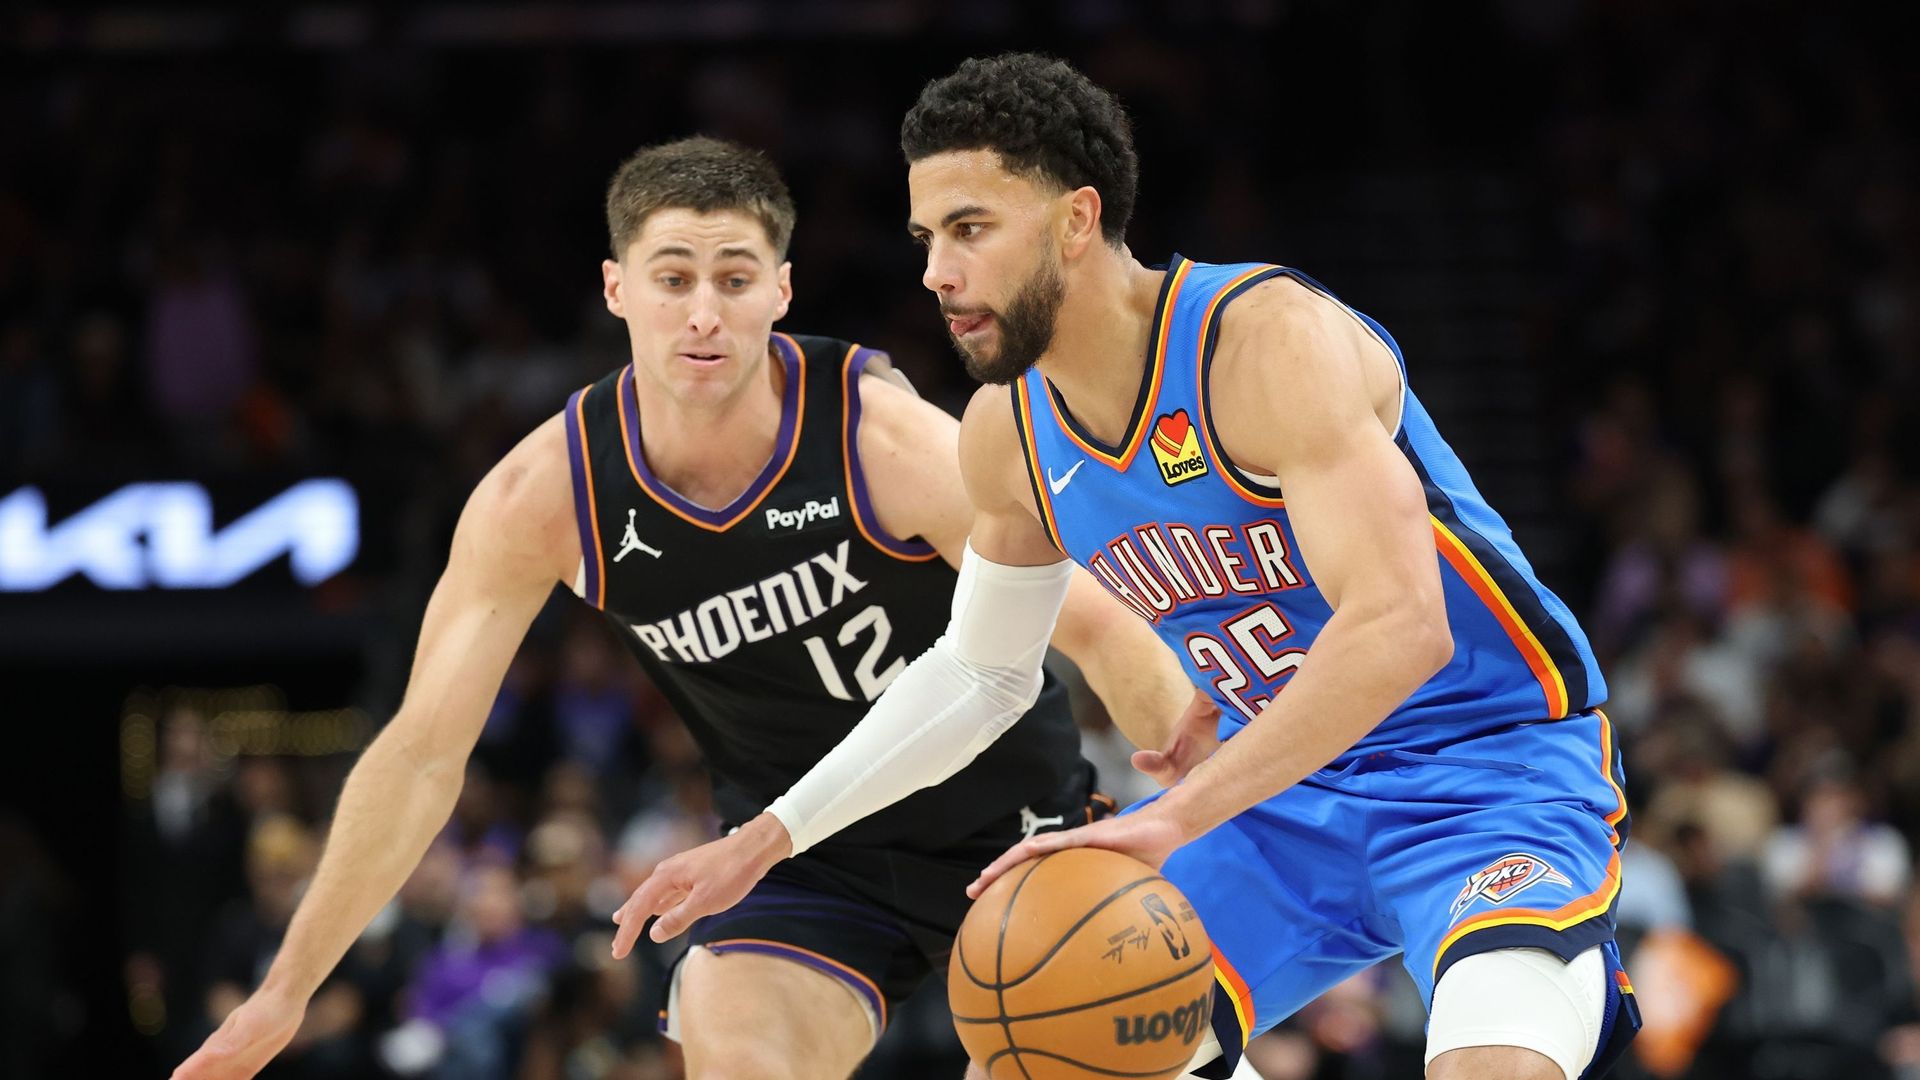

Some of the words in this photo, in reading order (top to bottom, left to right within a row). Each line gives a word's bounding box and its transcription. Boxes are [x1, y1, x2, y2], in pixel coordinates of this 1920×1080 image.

[766, 497, 839, 531] PayPal
[631, 540, 868, 663] PHOENIX
[1088, 518, 1307, 626] HUNDER
[803, 605, 906, 702] 12
[1184, 601, 1308, 721] 25
[1460, 862, 1532, 905] OKC
[1113, 981, 1215, 1046] ilson
